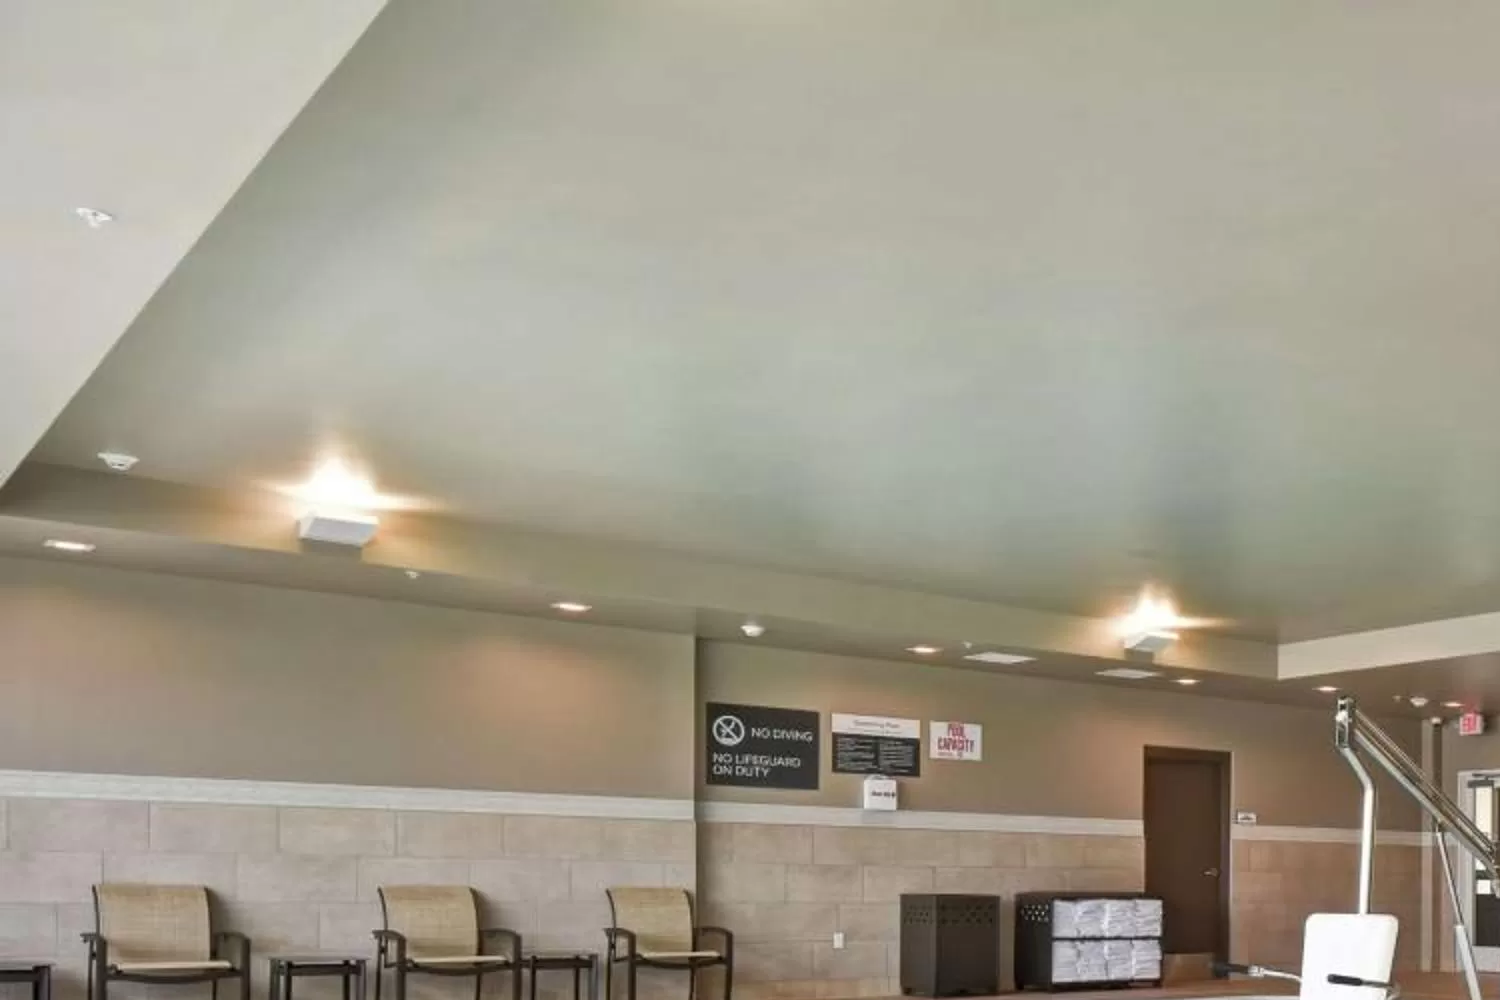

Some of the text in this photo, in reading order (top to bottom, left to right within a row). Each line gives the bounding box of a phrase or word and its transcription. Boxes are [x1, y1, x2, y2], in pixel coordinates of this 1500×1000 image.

[751, 727, 813, 742] NO DIVING
[713, 752, 801, 768] NO LIFEGUARD
[713, 764, 771, 777] ON DUTY
